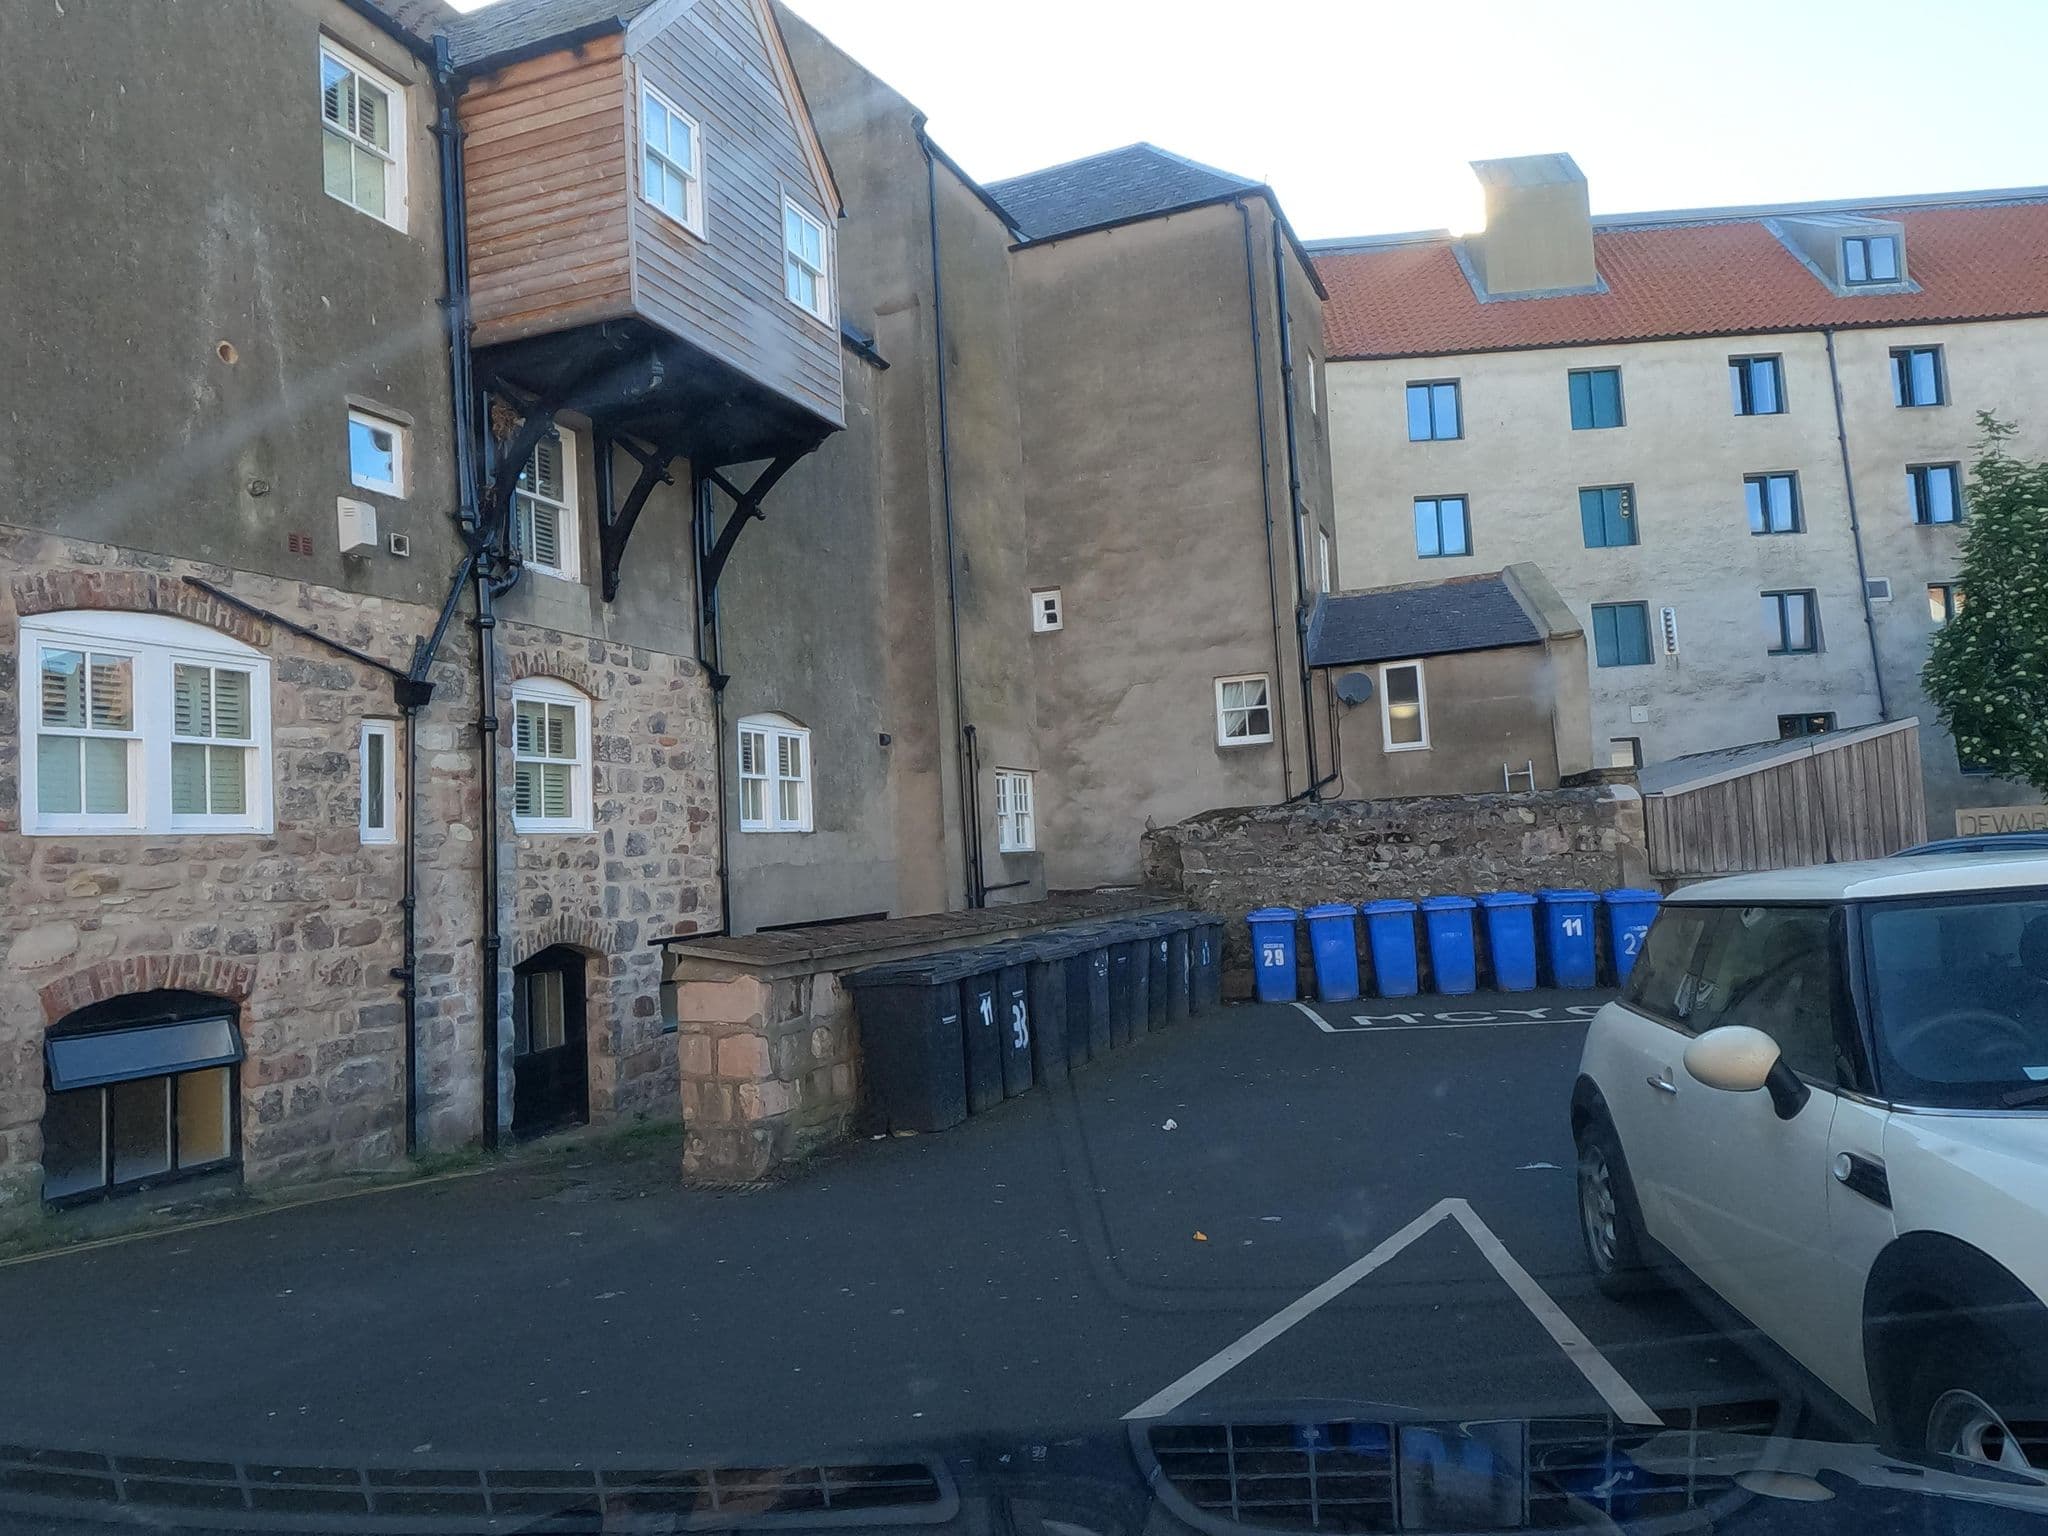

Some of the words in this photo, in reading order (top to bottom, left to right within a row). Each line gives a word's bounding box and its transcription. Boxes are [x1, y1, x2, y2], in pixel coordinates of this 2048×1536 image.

[1562, 918, 1582, 937] 11
[1263, 949, 1285, 967] 29
[980, 996, 993, 1026] 11
